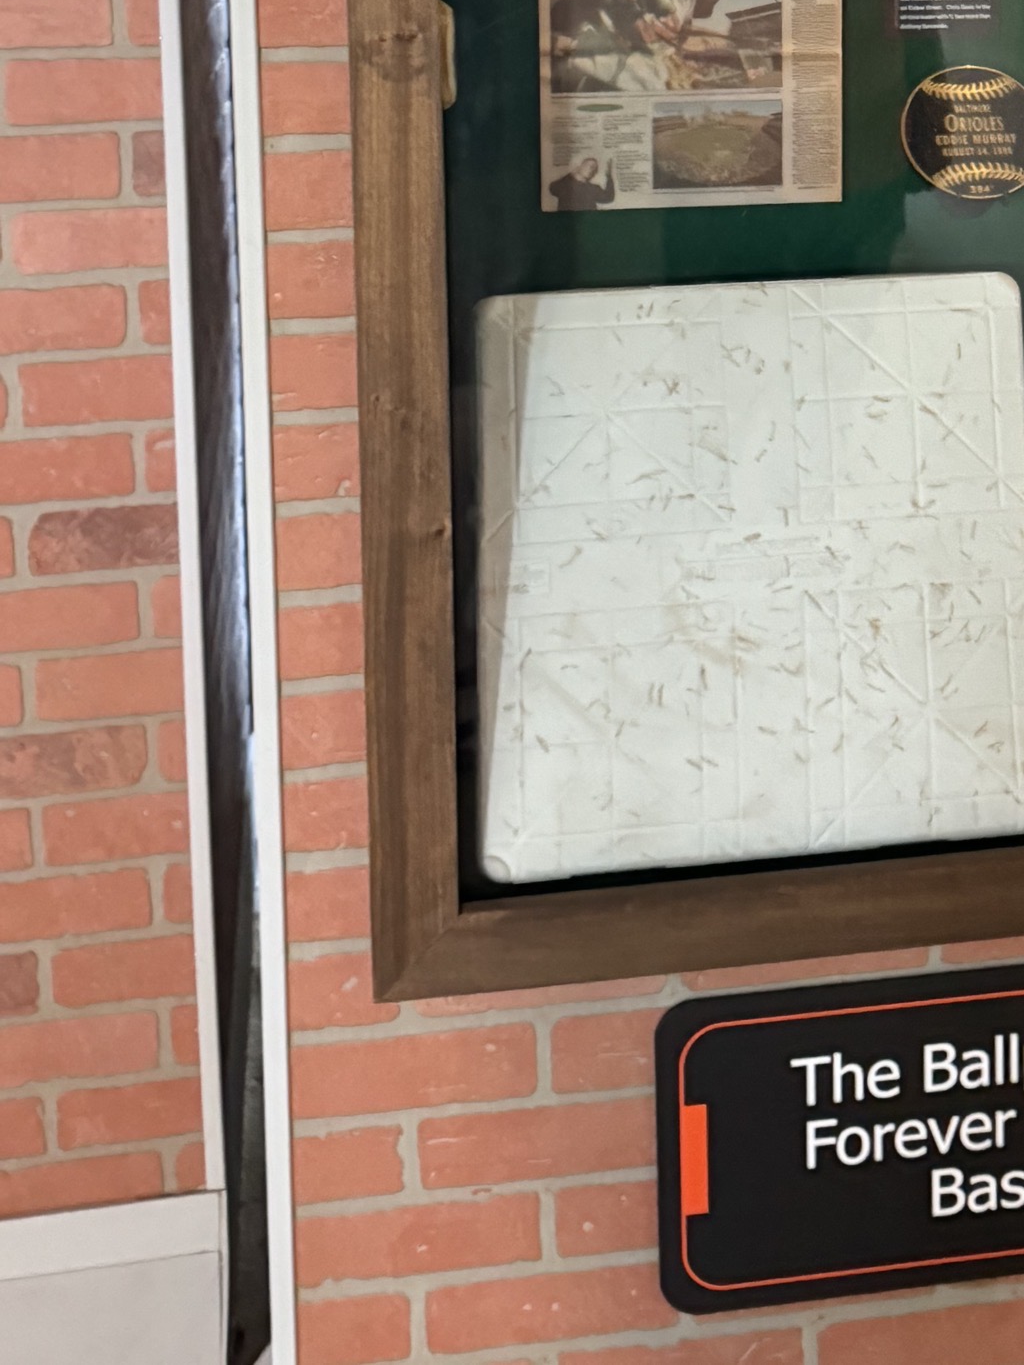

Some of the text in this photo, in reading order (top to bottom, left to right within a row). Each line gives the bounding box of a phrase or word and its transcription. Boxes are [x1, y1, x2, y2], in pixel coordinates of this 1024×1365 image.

[935, 133, 1017, 146] EDDIE MURRAY
[944, 114, 1004, 133] ORIOLES
[790, 1051, 901, 1106] The
[806, 1109, 1017, 1170] Forever
